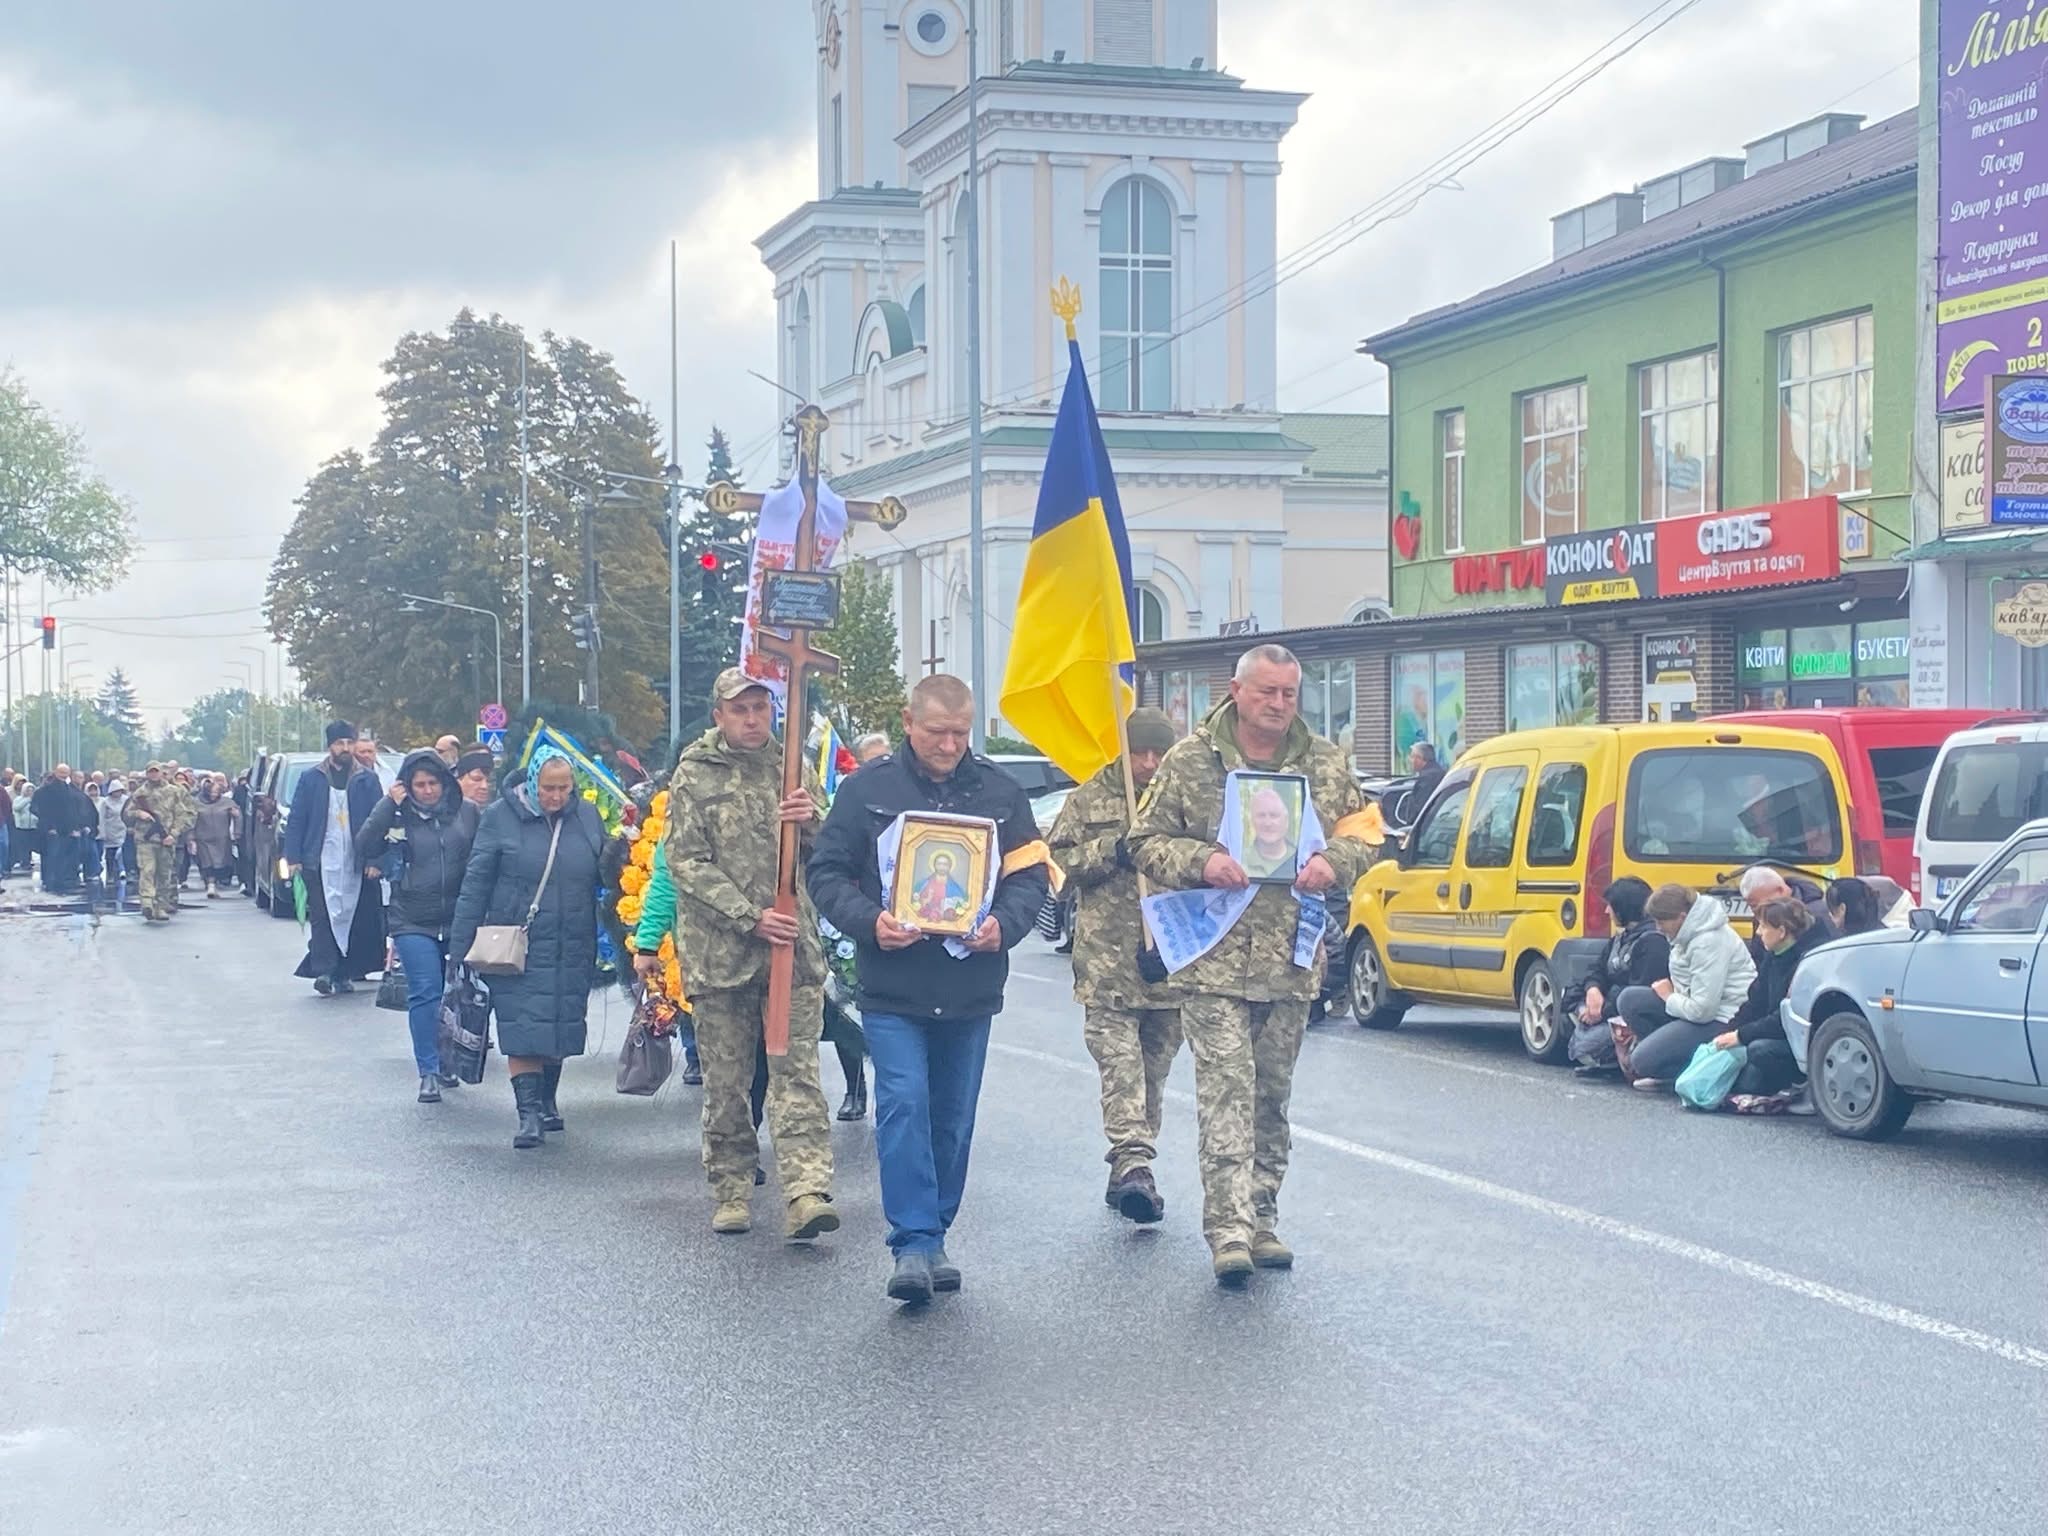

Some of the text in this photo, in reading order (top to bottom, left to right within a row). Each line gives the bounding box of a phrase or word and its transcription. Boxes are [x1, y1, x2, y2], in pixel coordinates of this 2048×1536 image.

[1967, 81, 2037, 119] Домашній
[1971, 107, 2038, 140] текстиль
[1979, 151, 2024, 176] Посуд
[1950, 198, 1990, 222] Декор
[1993, 190, 2019, 216] для
[1962, 231, 2038, 264] Подарунки
[2027, 317, 2042, 348] 2
[2006, 352, 2048, 374] пове
[1698, 512, 1772, 555] GABIS
[1754, 557, 1768, 573] та
[1745, 646, 1784, 668] КВІТИ
